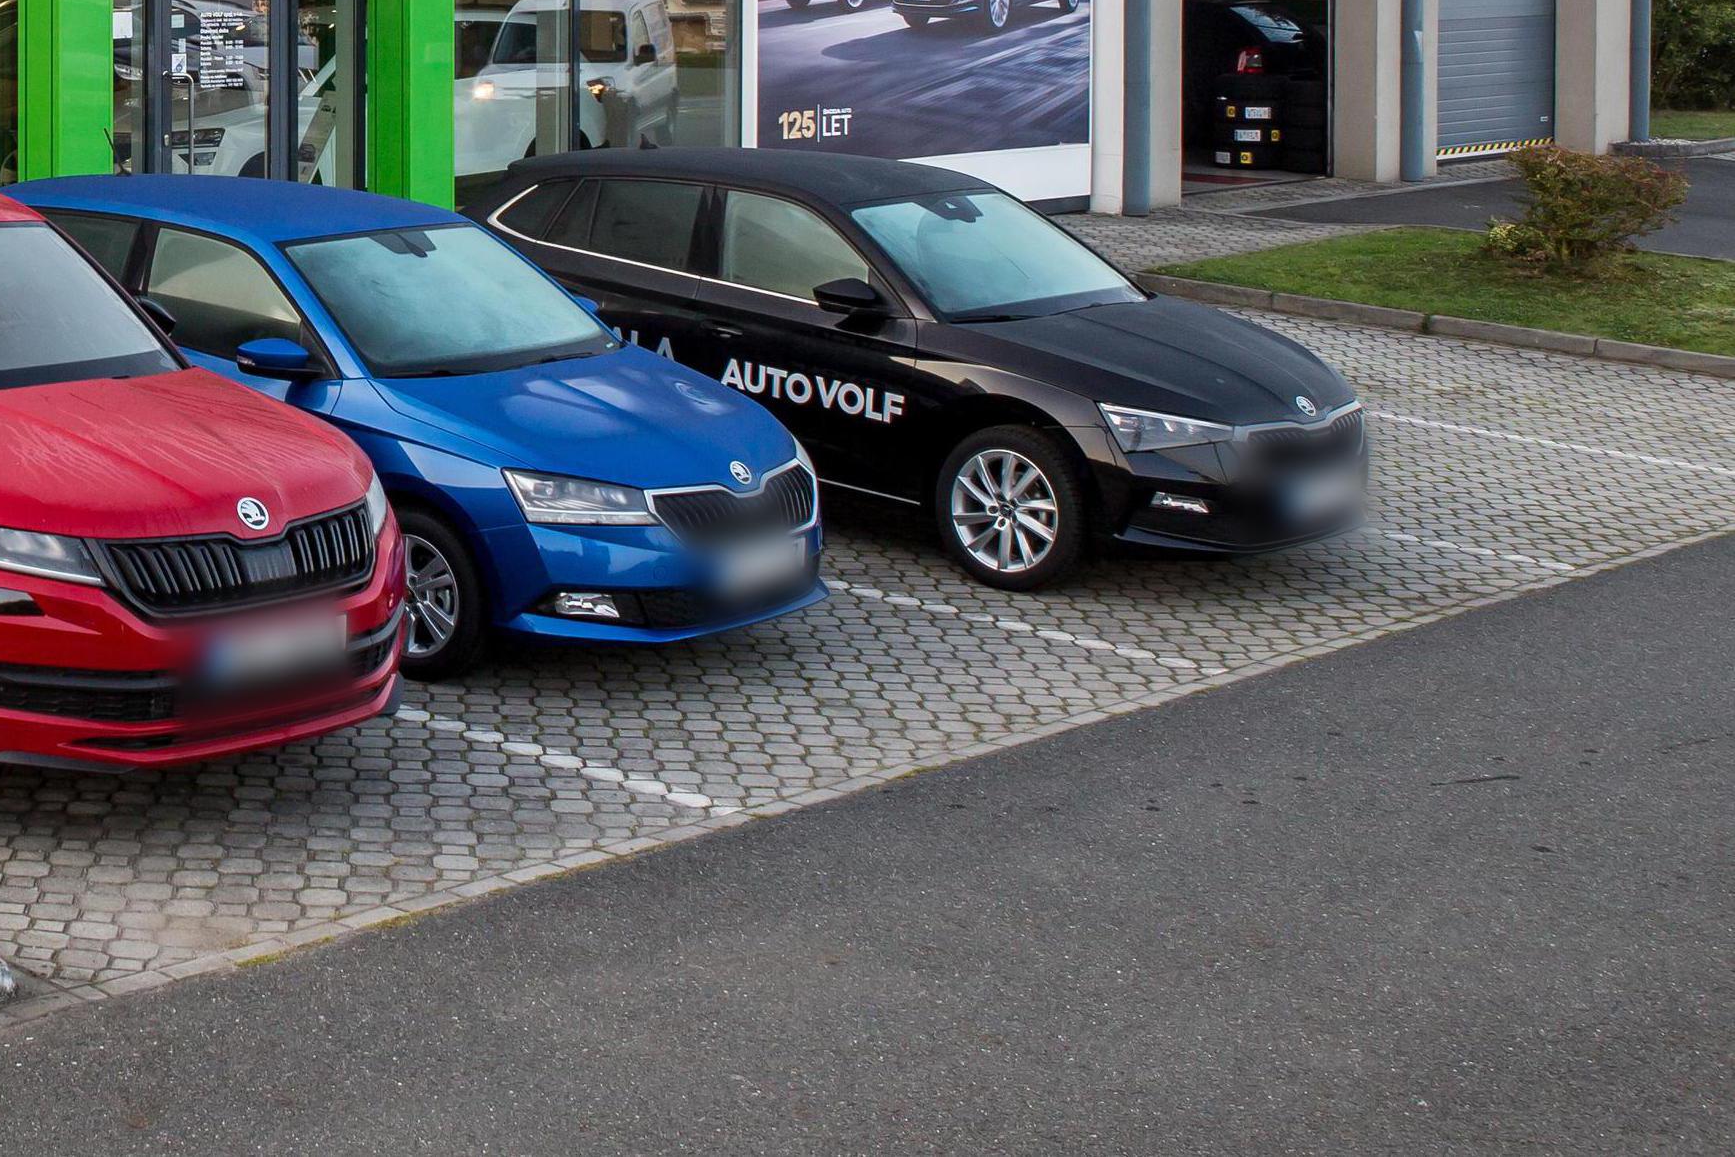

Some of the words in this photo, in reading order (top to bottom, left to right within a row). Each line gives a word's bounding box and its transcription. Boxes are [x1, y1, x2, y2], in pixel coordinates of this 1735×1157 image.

[778, 110, 816, 139] 125
[823, 114, 852, 136] LET
[721, 358, 813, 404] AUTO
[814, 375, 906, 423] VOLF
